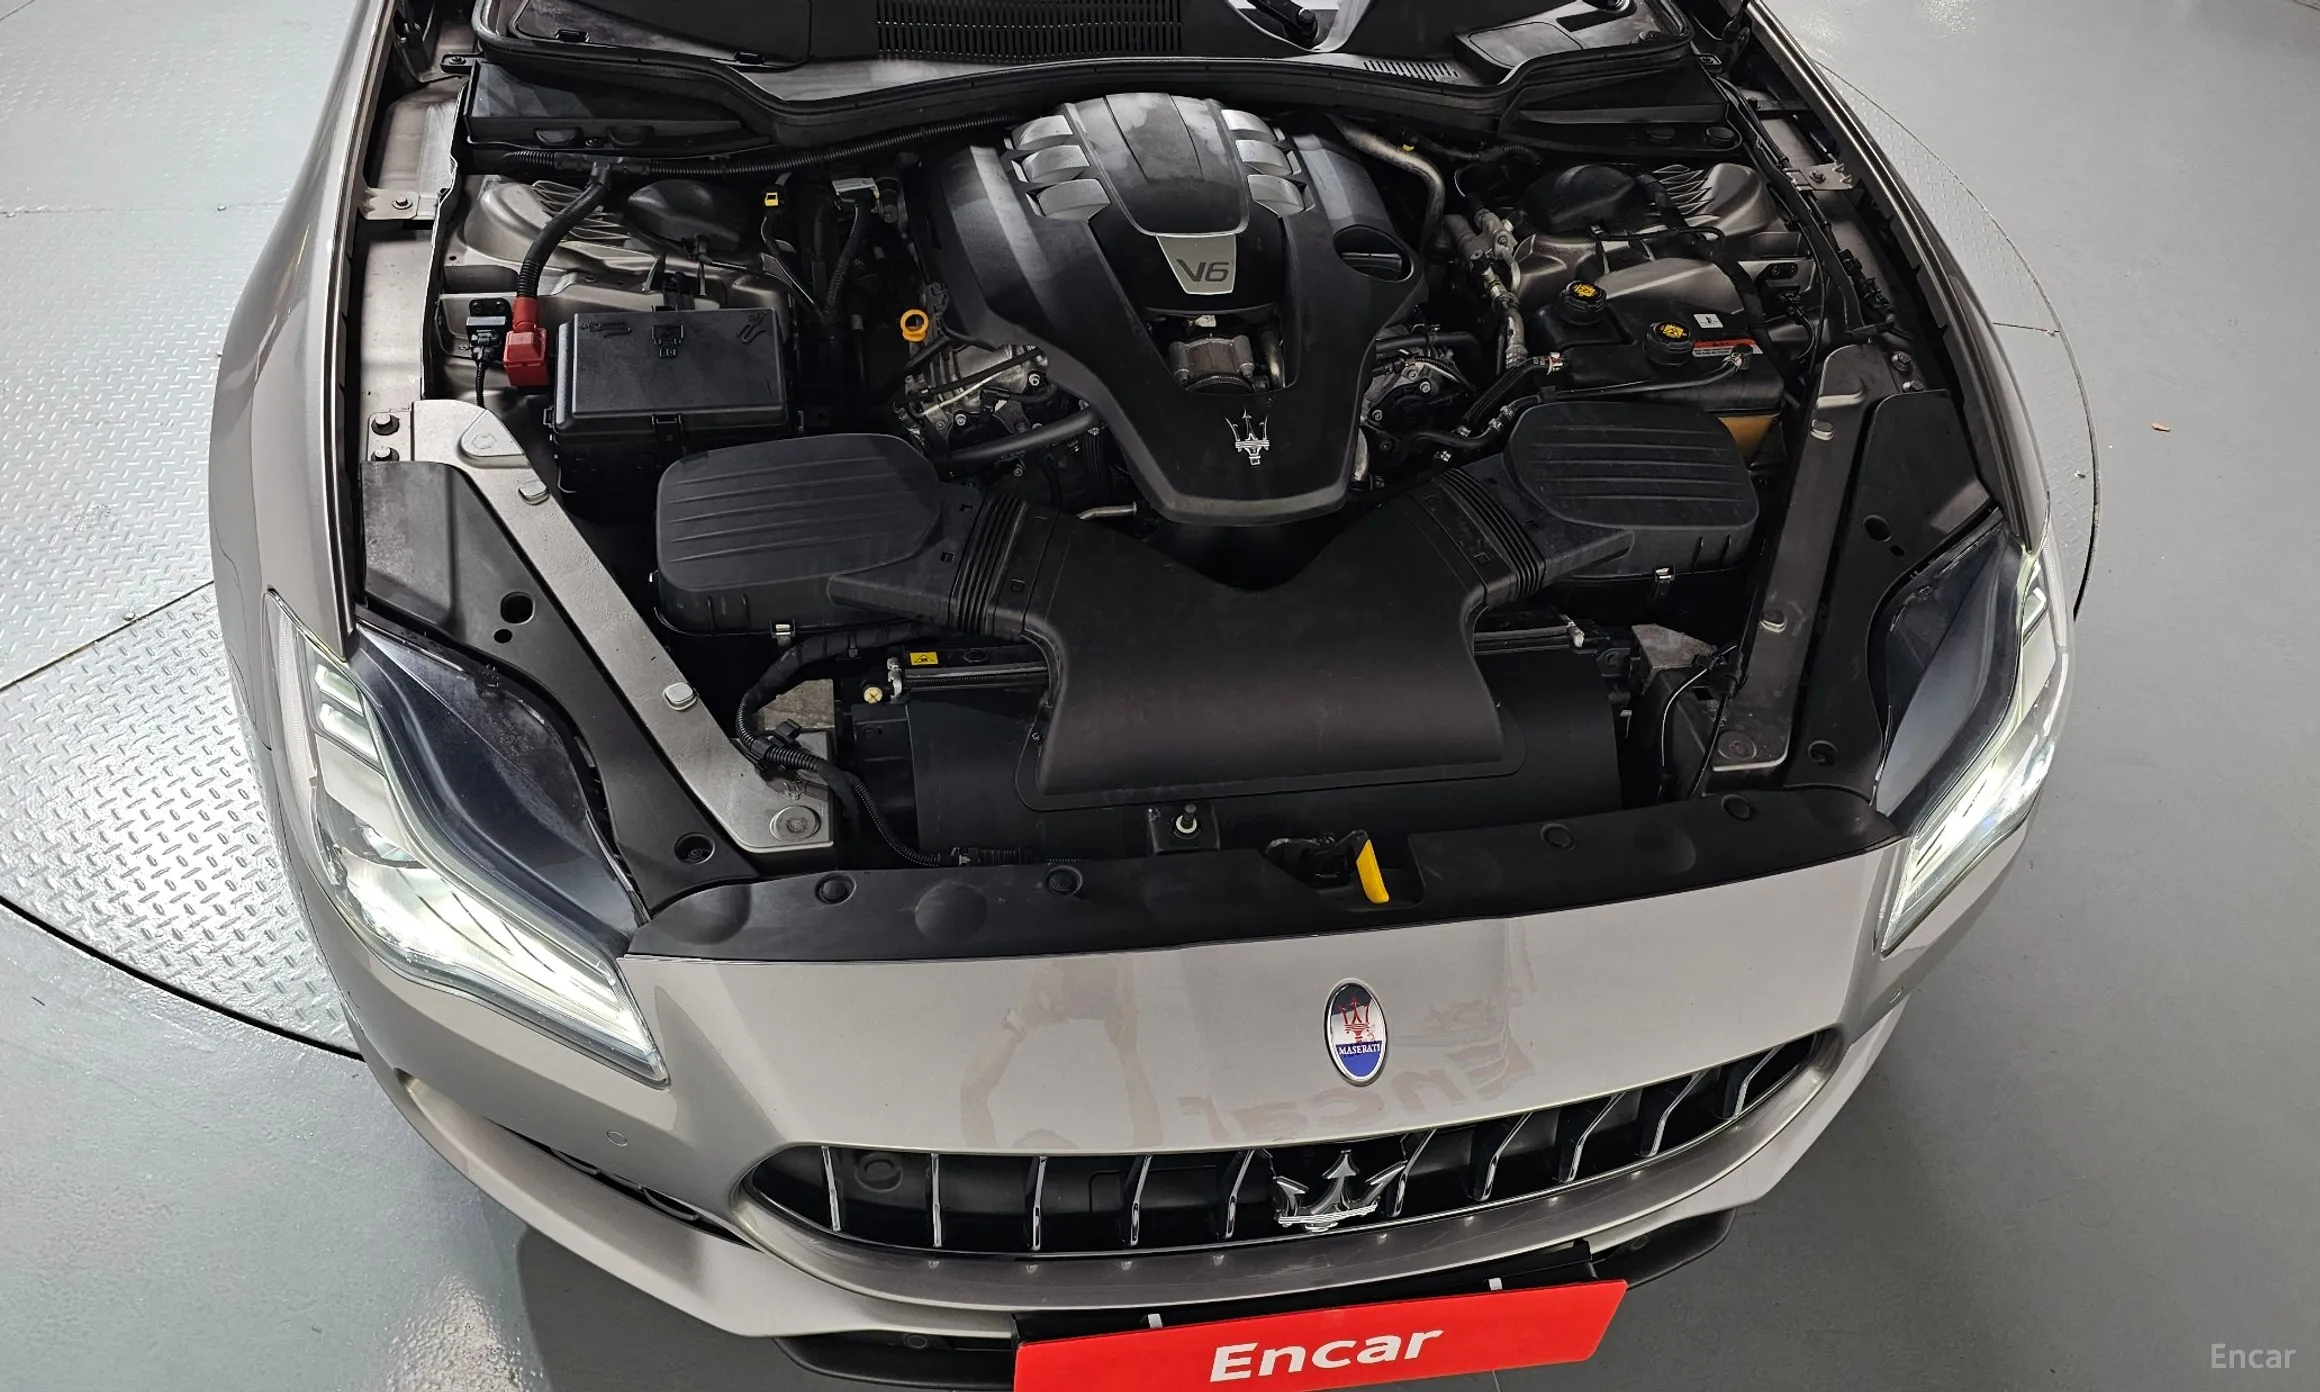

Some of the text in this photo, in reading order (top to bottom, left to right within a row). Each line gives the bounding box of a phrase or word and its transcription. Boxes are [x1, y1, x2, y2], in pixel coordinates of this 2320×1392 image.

[1176, 259, 1230, 282] V6
[1338, 1043, 1381, 1055] MASERATI
[1210, 1330, 1444, 1382] Encar
